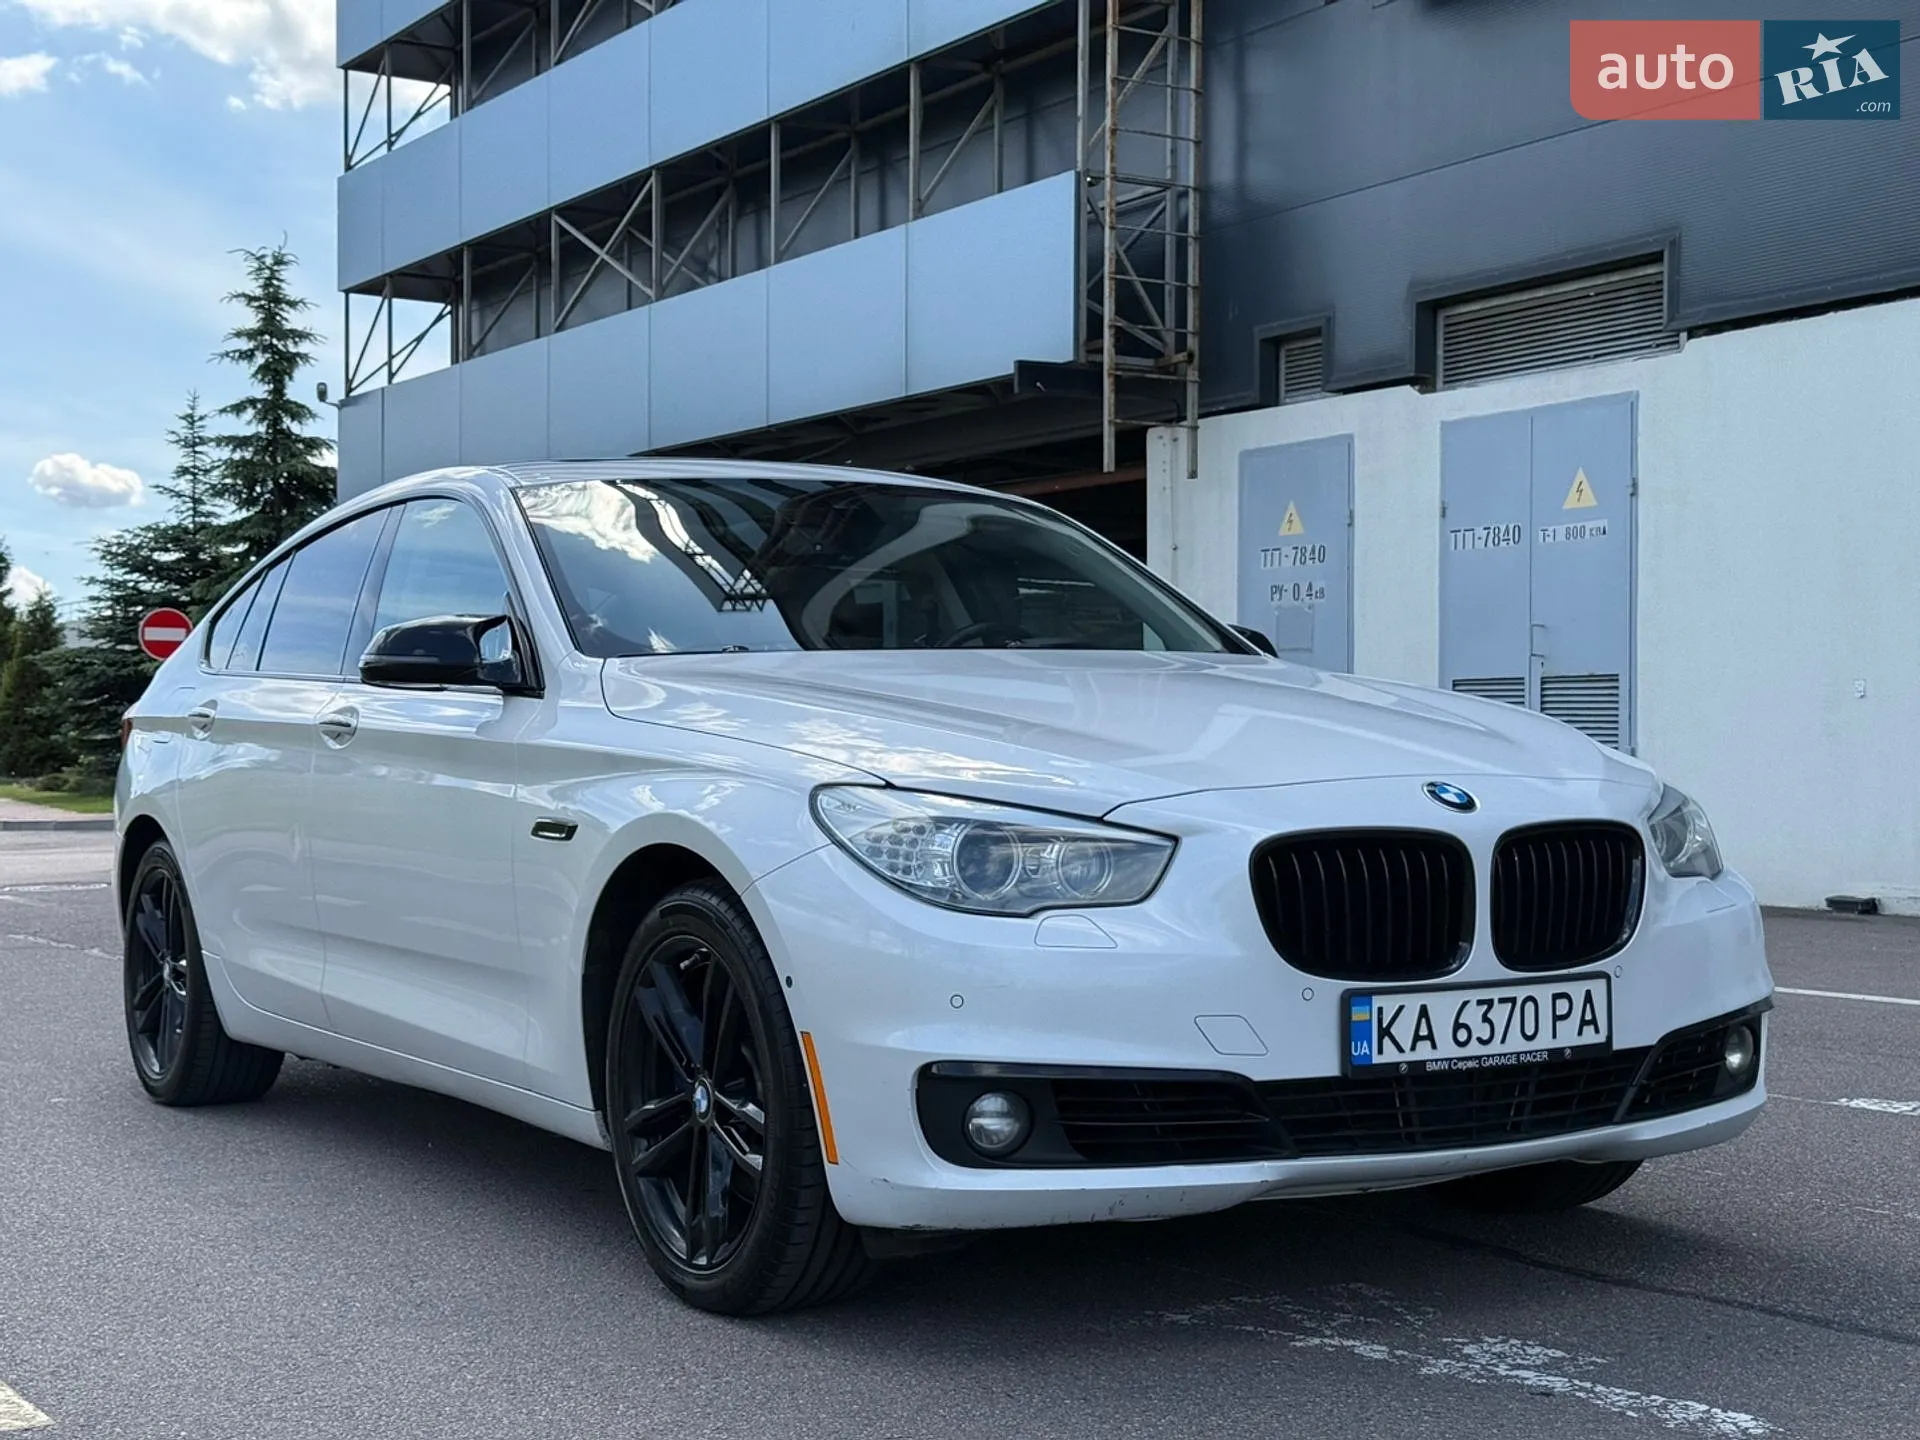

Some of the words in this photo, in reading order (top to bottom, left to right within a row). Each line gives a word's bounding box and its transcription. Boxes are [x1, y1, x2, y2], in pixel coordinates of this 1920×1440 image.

[1450, 524, 1521, 550] ТП-7840
[1565, 524, 1586, 541] 800
[1260, 544, 1326, 568] ТП-7840
[1376, 1003, 1438, 1056] KA
[1451, 994, 1540, 1049] 6370
[1551, 988, 1601, 1040] PA
[1351, 1040, 1371, 1056] UA
[1426, 1060, 1449, 1072] BMW
[1480, 1053, 1518, 1067] GARAGE
[1519, 1050, 1549, 1064] RACER
